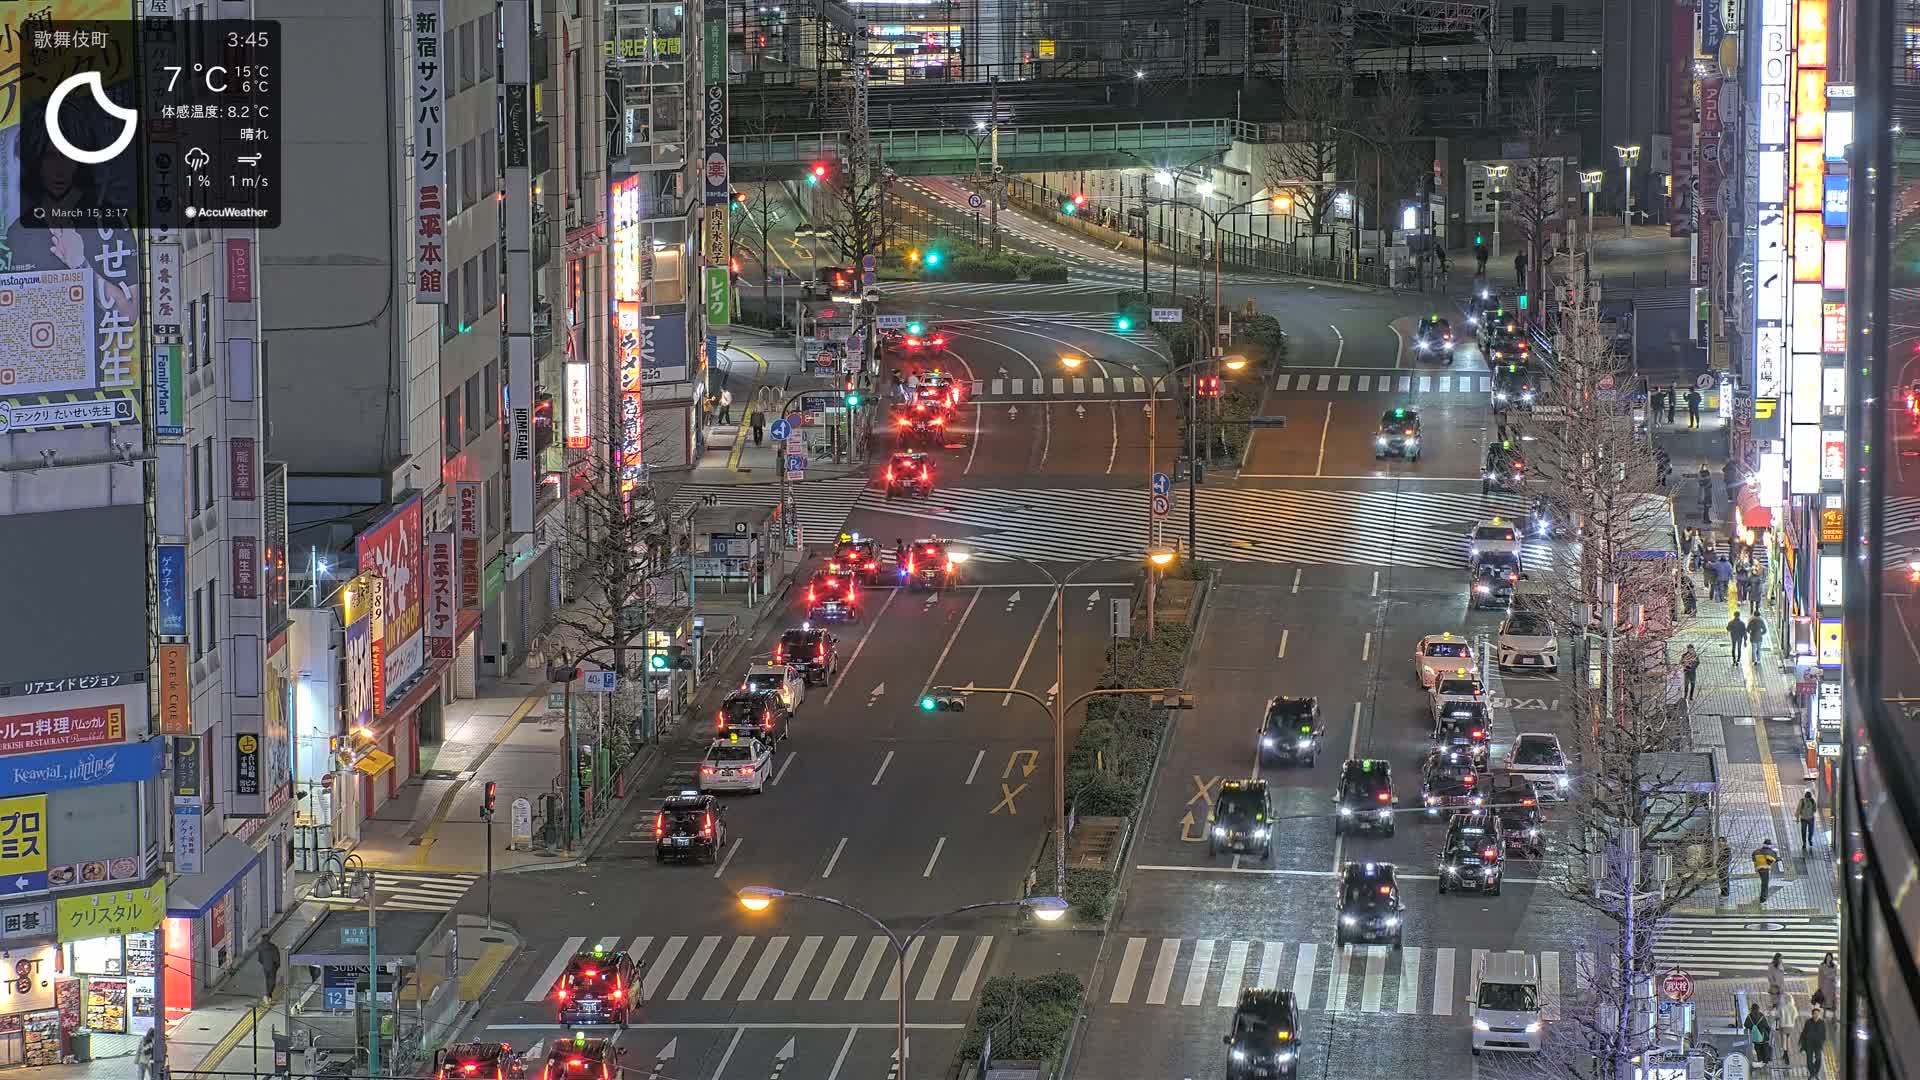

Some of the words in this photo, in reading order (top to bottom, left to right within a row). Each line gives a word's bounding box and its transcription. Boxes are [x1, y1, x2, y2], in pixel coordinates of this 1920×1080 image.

[1708, 0, 1719, 46] ントラル
[656, 37, 681, 55] 夜間
[416, 12, 443, 172] 新宿サンパーク
[1706, 88, 1718, 120] アコム
[709, 161, 725, 177] 薬
[419, 186, 442, 293] 三平本館
[711, 208, 723, 263] 肉汁水餃子
[0, 276, 40, 290] nstagram
[711, 277, 724, 315] レイク
[159, 325, 175, 334] 3F
[620, 332, 638, 388] ラーメン
[158, 354, 169, 416] FamilyMart
[15, 410, 49, 423] テンクリ
[54, 405, 112, 420] たいせい先生
[515, 408, 528, 461] HOMEGAME
[462, 487, 473, 532] GAME
[714, 542, 726, 553] 10
[432, 543, 450, 630] 三平ストア
[374, 582, 382, 621] 389
[25, 678, 75, 695] リアエイド
[79, 675, 120, 688] ビジョン
[110, 712, 119, 736] 5F
[25, 736, 70, 749] RESTAURANT
[5, 911, 41, 933] 囲碁
[70, 903, 143, 929] クリスタル
[327, 992, 342, 1005] 12
[1666, 981, 1688, 992] 消火栓
